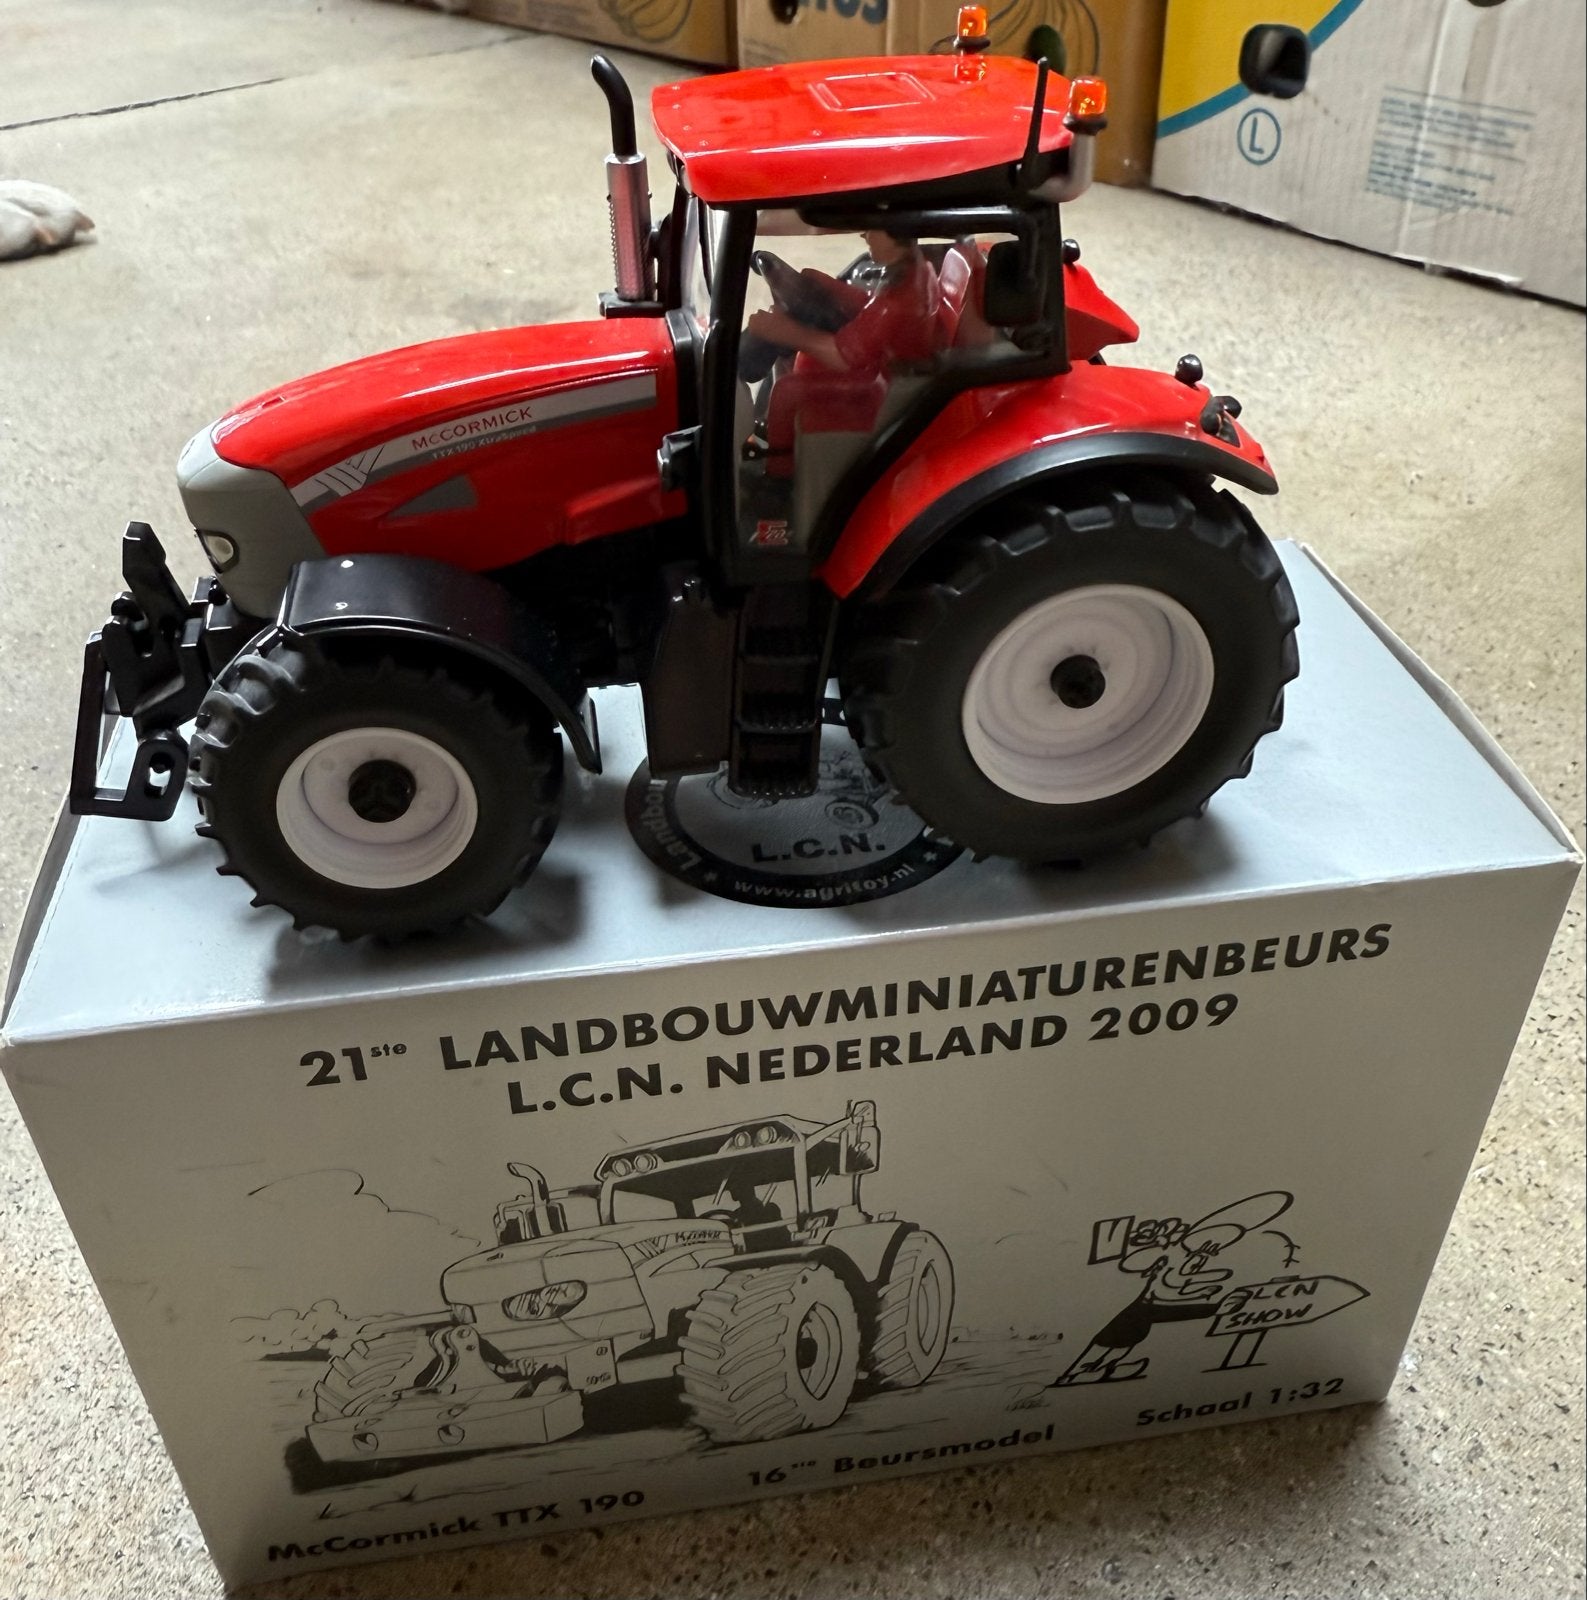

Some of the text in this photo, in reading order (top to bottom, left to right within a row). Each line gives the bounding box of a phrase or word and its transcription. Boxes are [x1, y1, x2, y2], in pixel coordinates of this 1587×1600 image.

[752, 832, 886, 863] L.C.N.
[734, 863, 916, 901] www.agritoy.nl
[439, 923, 1393, 1071] LANDBOUWMINIATURENBEURS
[508, 993, 1240, 1115] L.C.N. NEDERLAND 2009
[1225, 1303, 1314, 1329] SHOW
[1136, 1377, 1345, 1426] Schaal 1:32
[834, 1424, 1056, 1473] Beursmodel
[268, 1490, 646, 1562] McCormick TTX 190
